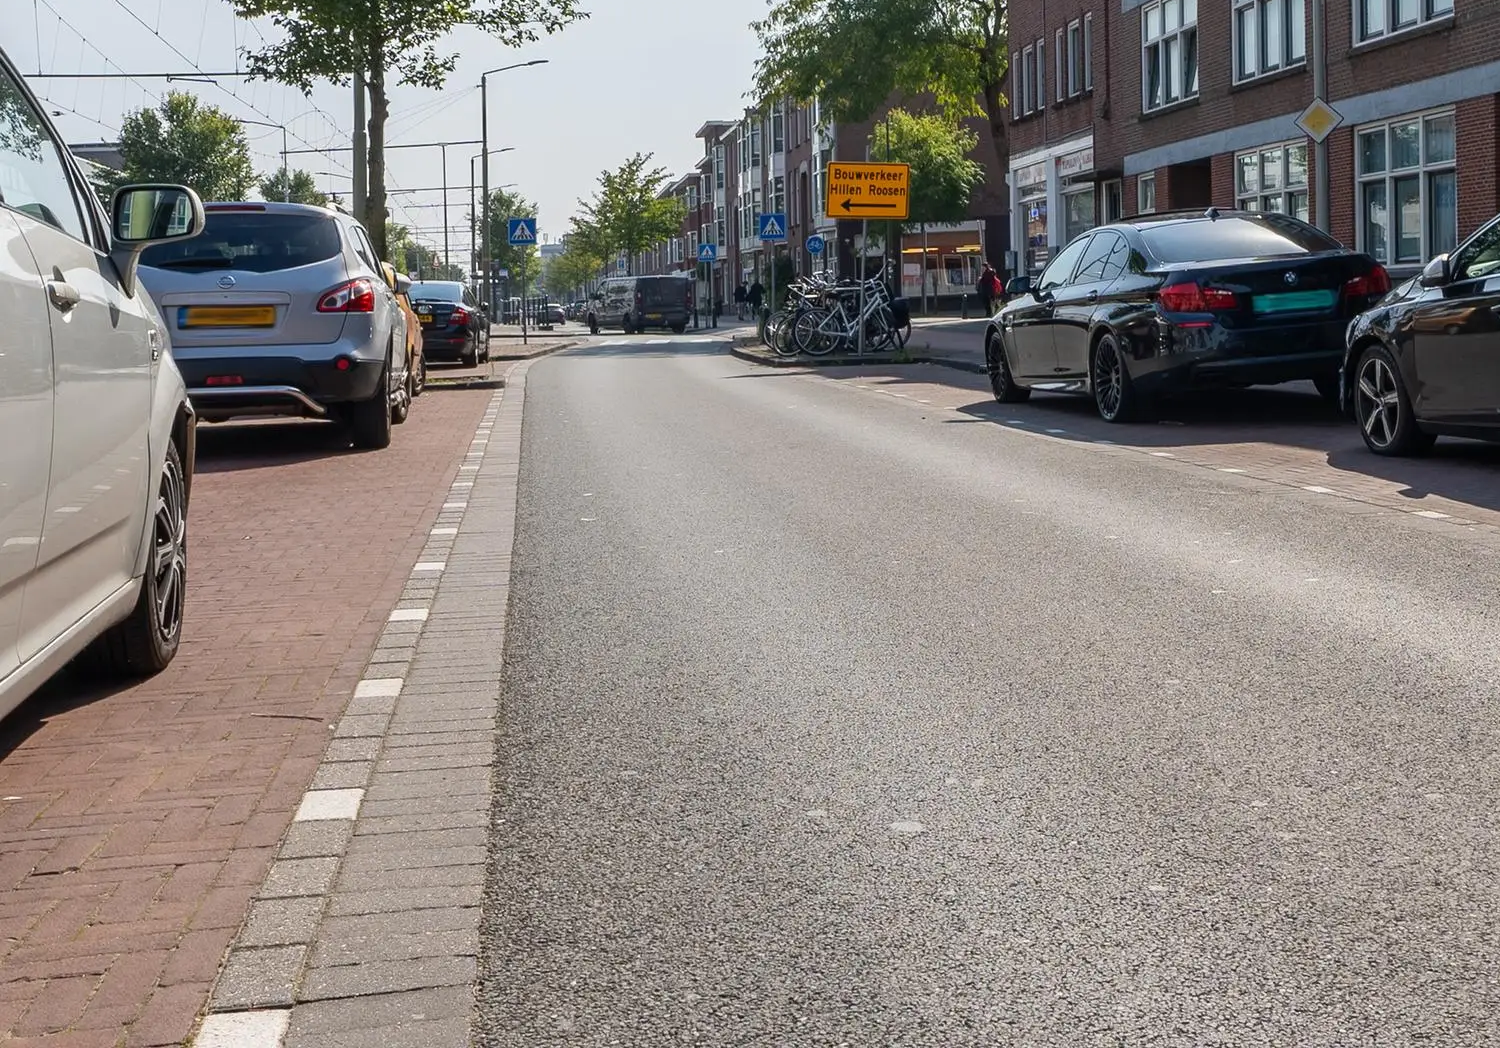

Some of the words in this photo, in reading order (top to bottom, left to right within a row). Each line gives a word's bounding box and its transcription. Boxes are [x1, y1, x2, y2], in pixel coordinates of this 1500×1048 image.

[834, 168, 903, 182] Bouwverkeer
[830, 183, 862, 196] Hillen
[868, 184, 906, 197] Roosen
